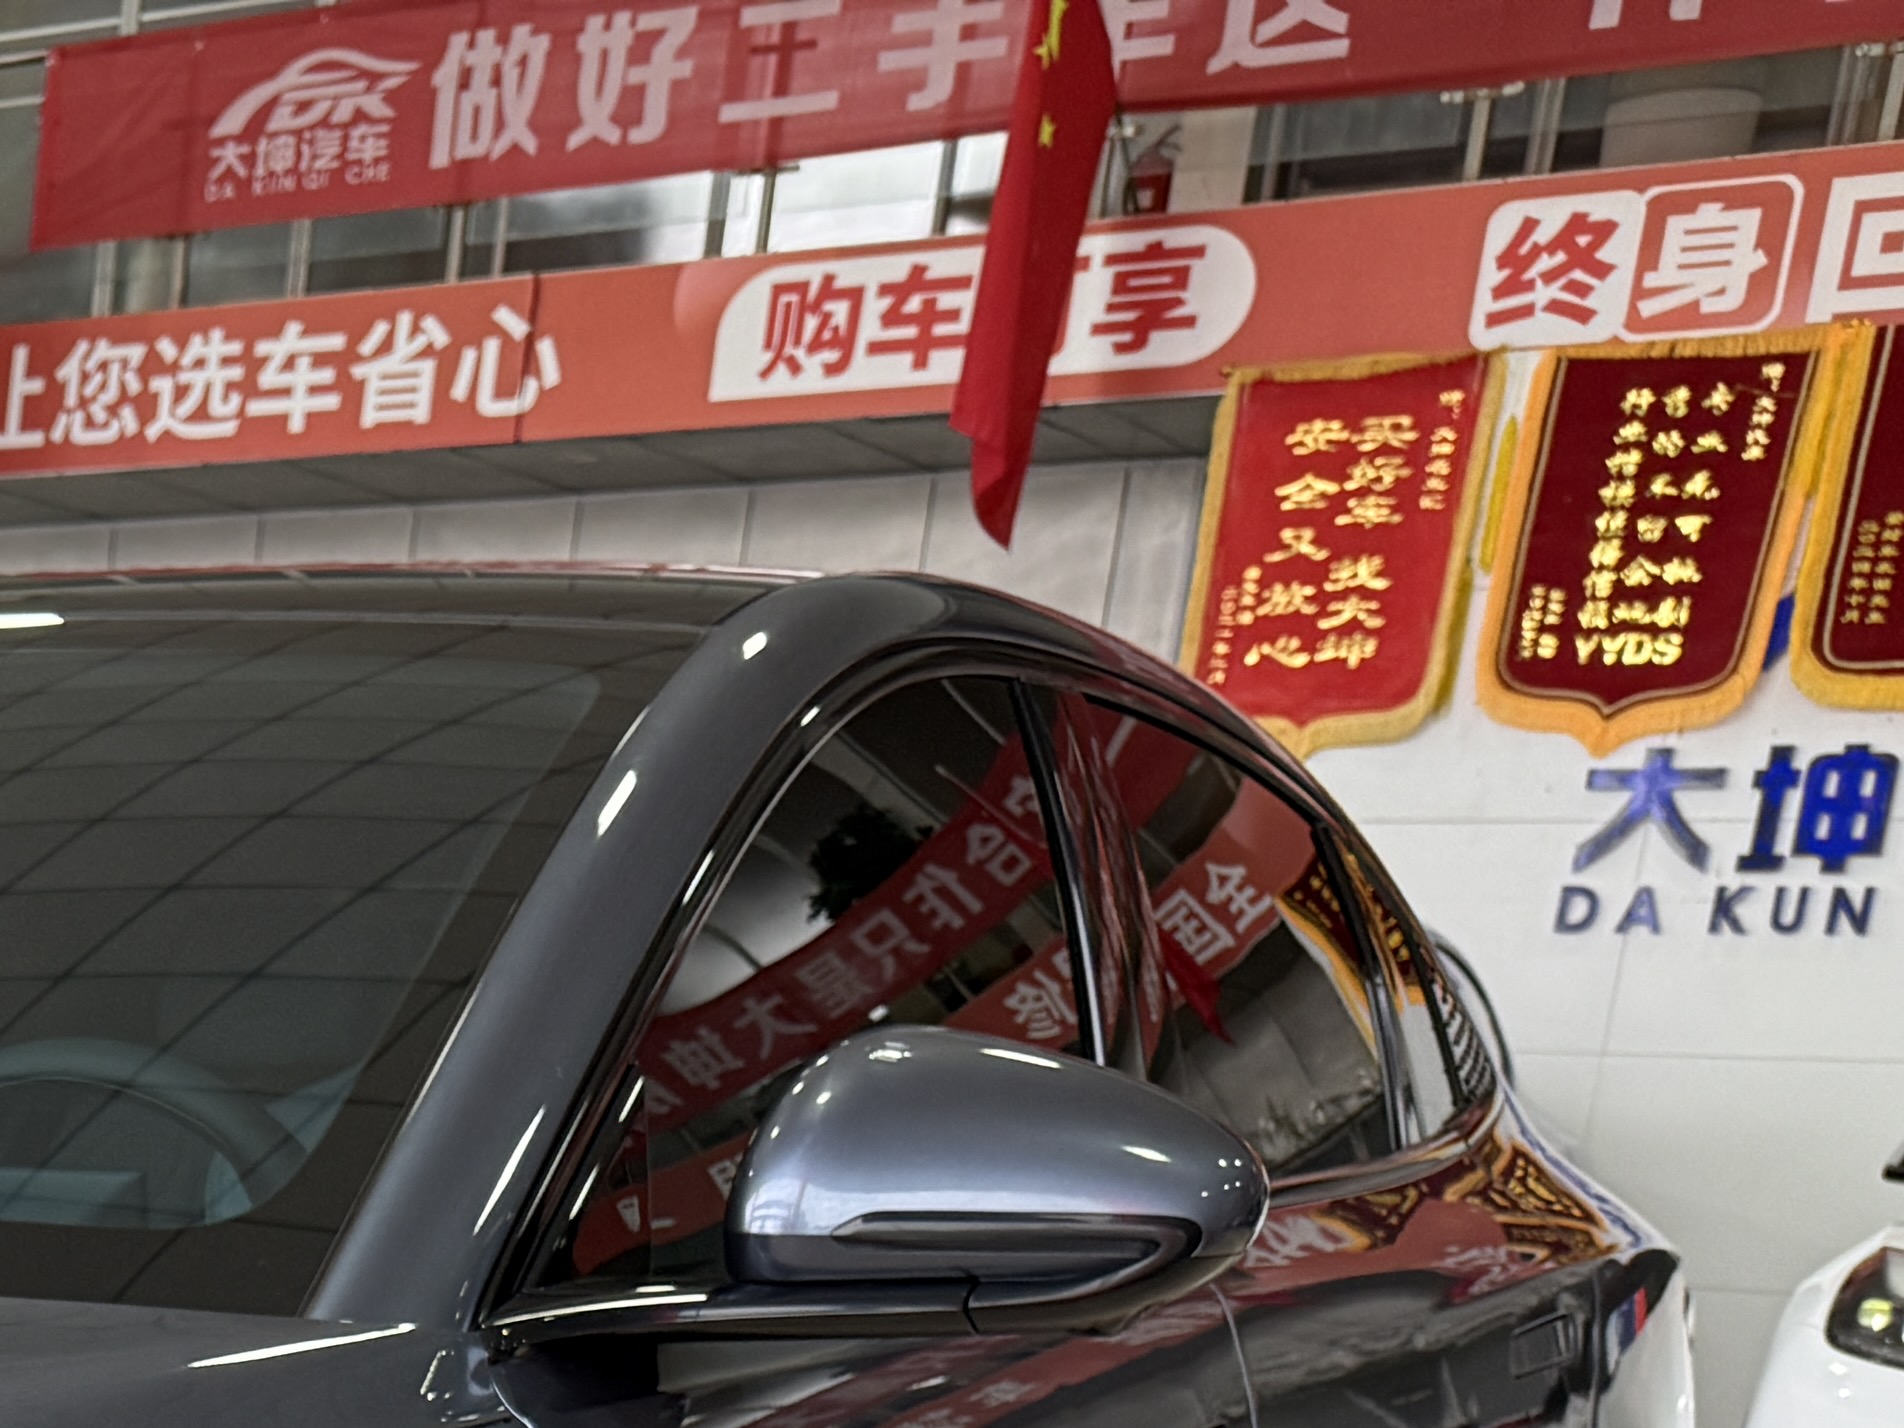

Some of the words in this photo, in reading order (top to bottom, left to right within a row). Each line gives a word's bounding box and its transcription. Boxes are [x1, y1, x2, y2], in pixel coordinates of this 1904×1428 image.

[206, 122, 393, 182] 大坤汽车
[759, 240, 1208, 381] 购车享
[1574, 630, 1685, 666] YYDS
[1571, 743, 1901, 875] 大坤
[1553, 884, 1662, 935] DA
[1706, 885, 1877, 937] KUN
